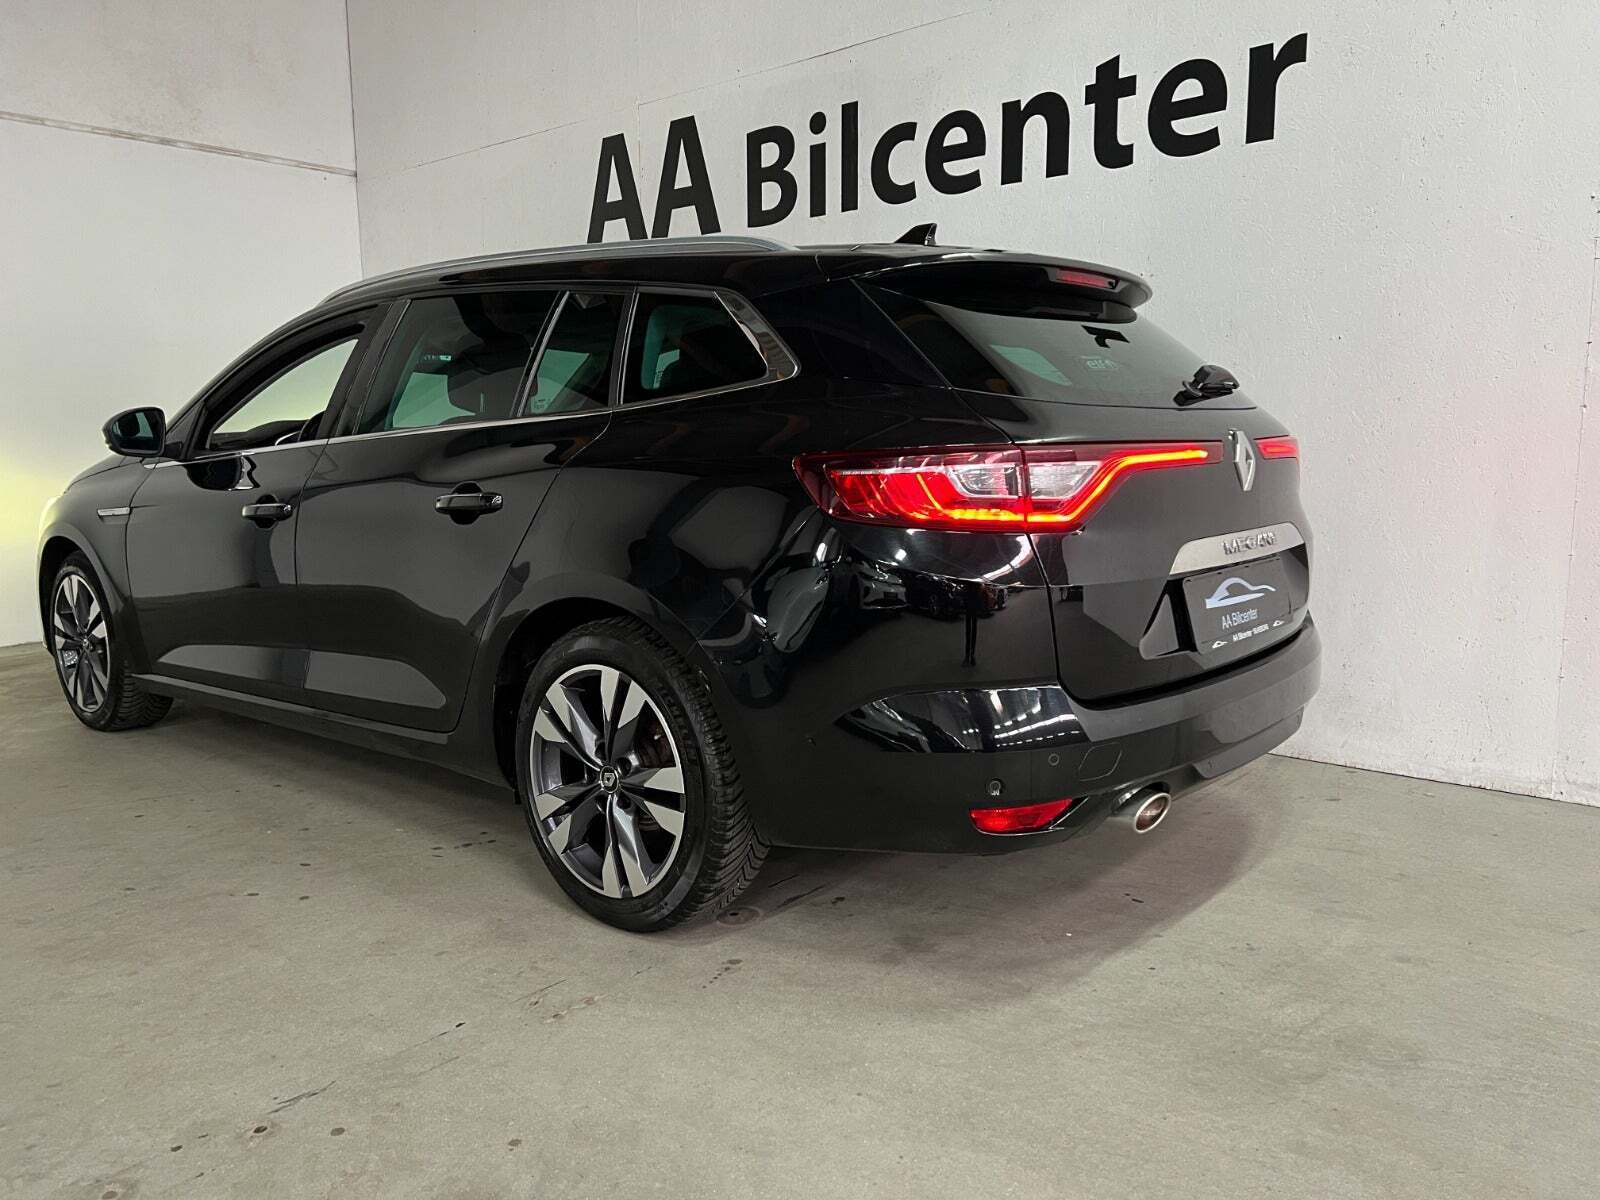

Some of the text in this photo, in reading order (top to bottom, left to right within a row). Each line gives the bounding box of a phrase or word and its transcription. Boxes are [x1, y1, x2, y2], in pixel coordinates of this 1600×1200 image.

[587, 32, 1308, 244] AA Bilcenter
[1221, 609, 1258, 630] AA Bilcenter
